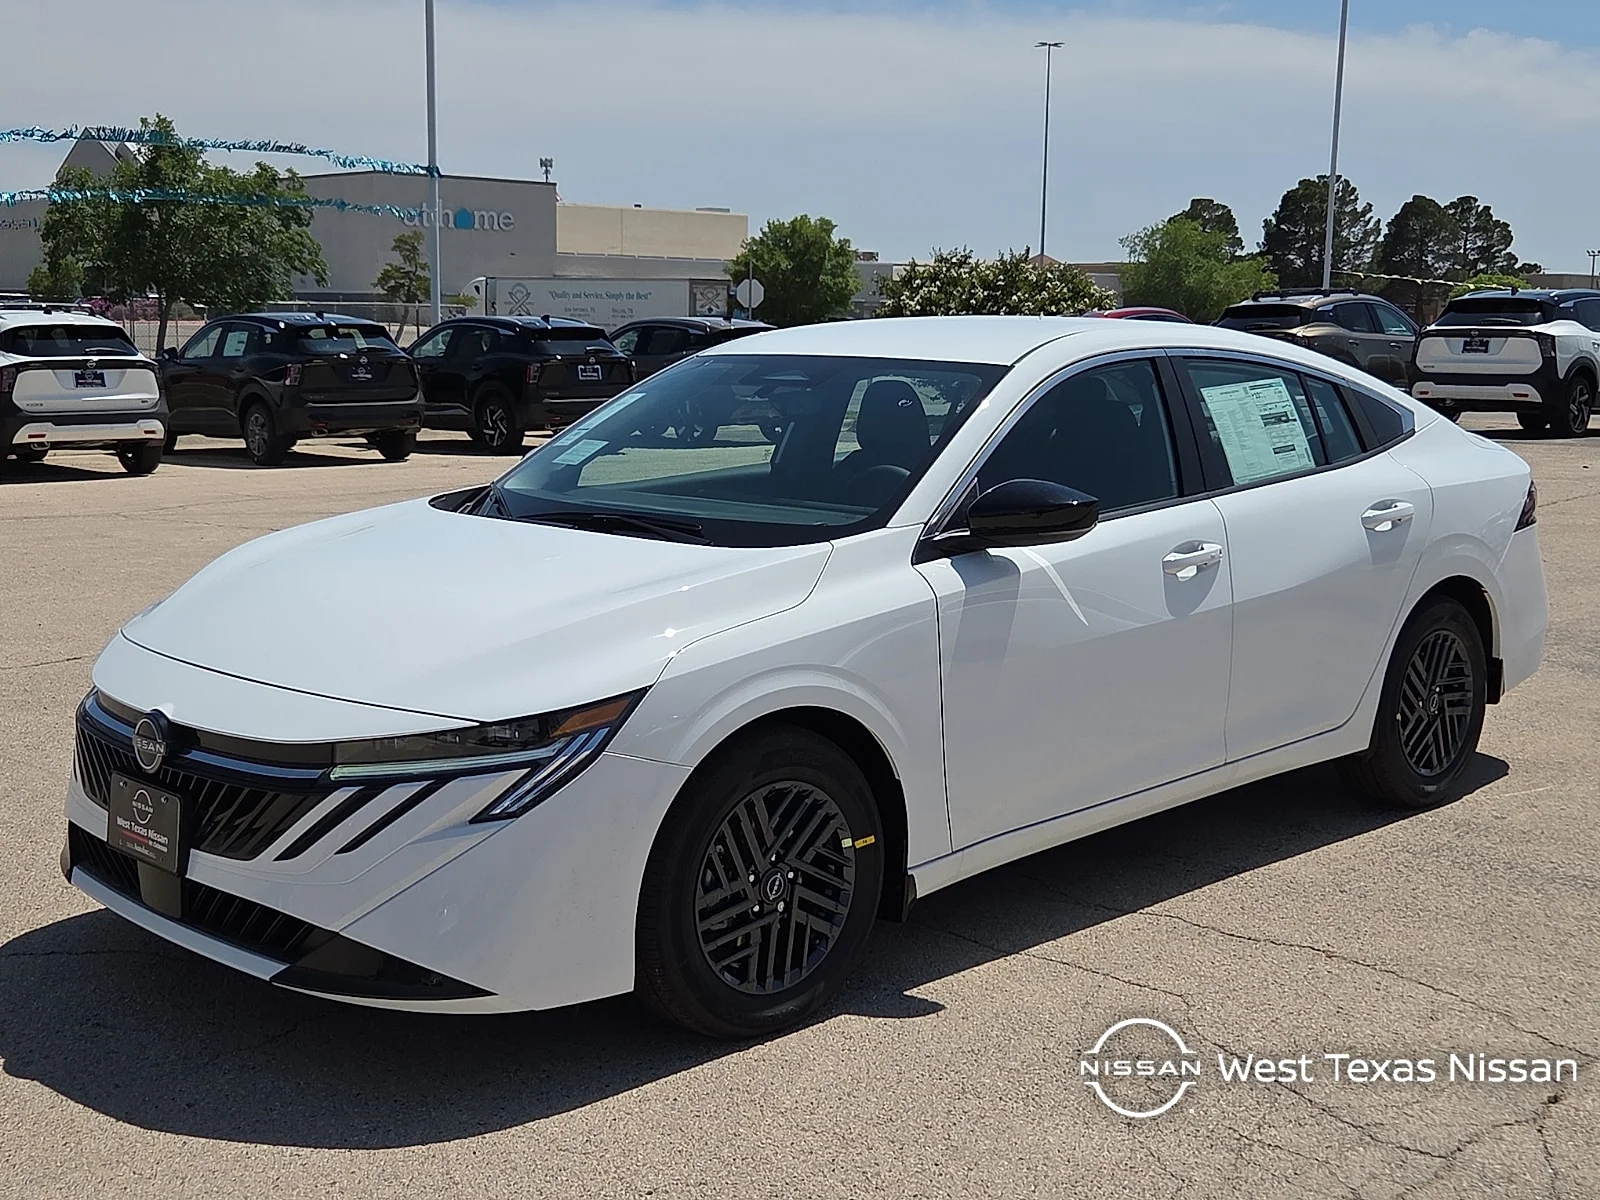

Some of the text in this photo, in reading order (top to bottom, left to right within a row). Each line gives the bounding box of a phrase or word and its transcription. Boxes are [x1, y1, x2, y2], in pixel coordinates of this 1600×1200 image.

[625, 291, 635, 300] the
[132, 800, 154, 813] NISSAN
[131, 821, 148, 837] Texas
[148, 829, 168, 846] Nissan
